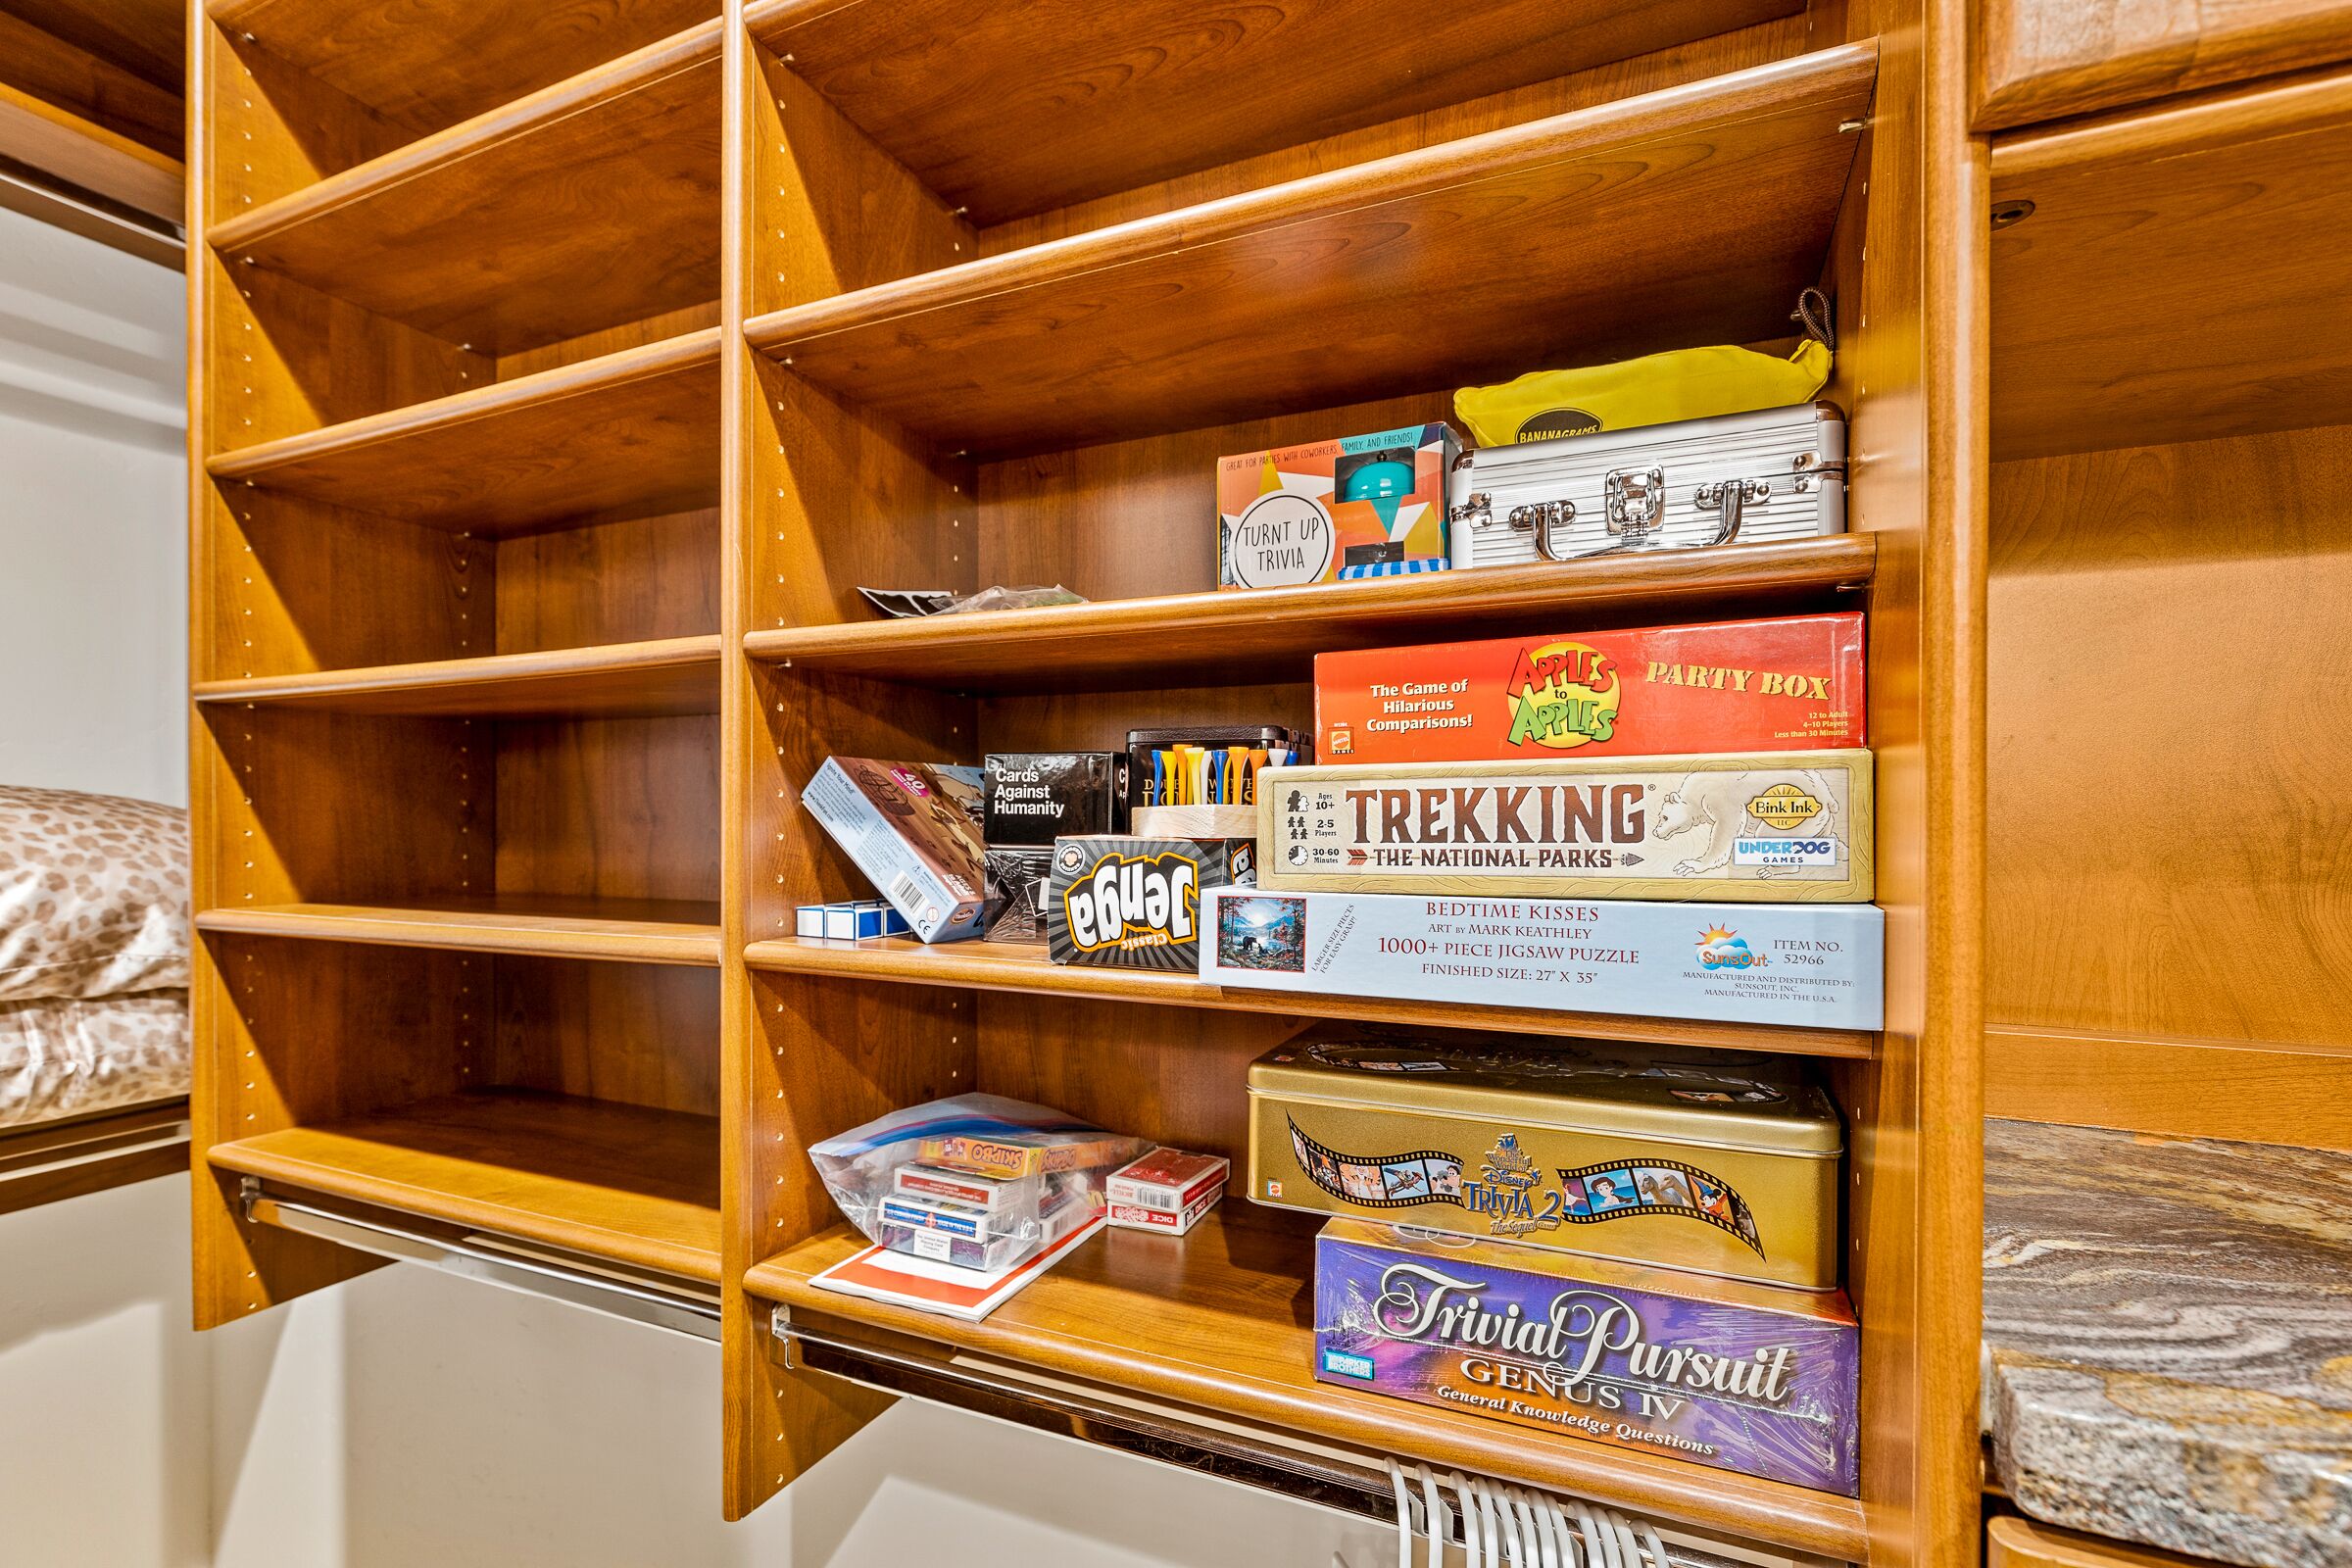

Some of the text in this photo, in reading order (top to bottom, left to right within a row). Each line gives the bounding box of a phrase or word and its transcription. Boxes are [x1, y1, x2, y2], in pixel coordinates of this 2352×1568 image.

[1519, 424, 1597, 444] BANANAGRAMS
[1226, 461, 1243, 470] GREAT
[1246, 458, 1256, 468] FOR
[1259, 454, 1280, 466] PARTIES
[1283, 452, 1298, 464] WITH
[1300, 445, 1337, 460] COWORKERS
[1367, 436, 1382, 448] AND
[1384, 431, 1413, 445] FRIENDS!
[1243, 516, 1319, 548] TURNT UP
[1257, 547, 1305, 571] TRIVIA
[1506, 647, 1618, 699] APPLES
[1645, 662, 1832, 701] PARTY BOX
[1370, 678, 1469, 698] The Game of
[1554, 689, 1568, 700] to
[1383, 699, 1454, 714] Hilarious
[1366, 713, 1473, 734] Comparisons!
[1507, 695, 1619, 747] APPLES
[1822, 720, 1848, 729] Players
[1820, 728, 1848, 737] Minutes
[905, 773, 926, 790] 40
[995, 767, 1039, 782] Cards
[994, 784, 1051, 802] Against
[994, 801, 1065, 818] Humanity
[1315, 801, 1335, 810] 10+
[1346, 784, 1645, 844] TREKKING
[1755, 801, 1814, 813] Bink Ink
[1317, 819, 1335, 828] 2-5
[1373, 848, 1613, 868] THE NATIONAL PARKS
[1069, 862, 1195, 948] Jenga
[1426, 902, 1599, 922] BEDTIME KISSES
[1311, 904, 1354, 971] LARGER SIZE PIECES
[1428, 923, 1452, 933] ART
[1468, 924, 1511, 936] MARK
[1515, 926, 1592, 940] KEATHLEY
[1120, 933, 1168, 952] Classic
[1378, 937, 1640, 964] 1000+ PIECE JIGSAW PUZZLE
[1773, 939, 1843, 953] ITEM NO.
[1320, 957, 1332, 974] FOR
[1329, 941, 1342, 958] EASY
[1702, 950, 1768, 967] SunsOut
[1784, 954, 1825, 965] 52966
[1422, 963, 1494, 978] FINISHED
[1496, 967, 1533, 981] SIZE:
[1559, 971, 1570, 982] X
[1683, 971, 1755, 982] MANUFACTURED
[1779, 976, 1840, 987] DISTRIBUTED
[1704, 989, 1778, 1000] MANUFACTURED
[1462, 1179, 1562, 1225] TRIVIA 2
[1152, 1213, 1174, 1224] DICE
[1491, 1219, 1506, 1235] The
[1508, 1218, 1538, 1238] Sequel
[1373, 1263, 1791, 1402] Trivial Pursuit
[1459, 1358, 1687, 1421] GENUS IV
[1437, 1385, 1715, 1455] General Knowledge Questions
